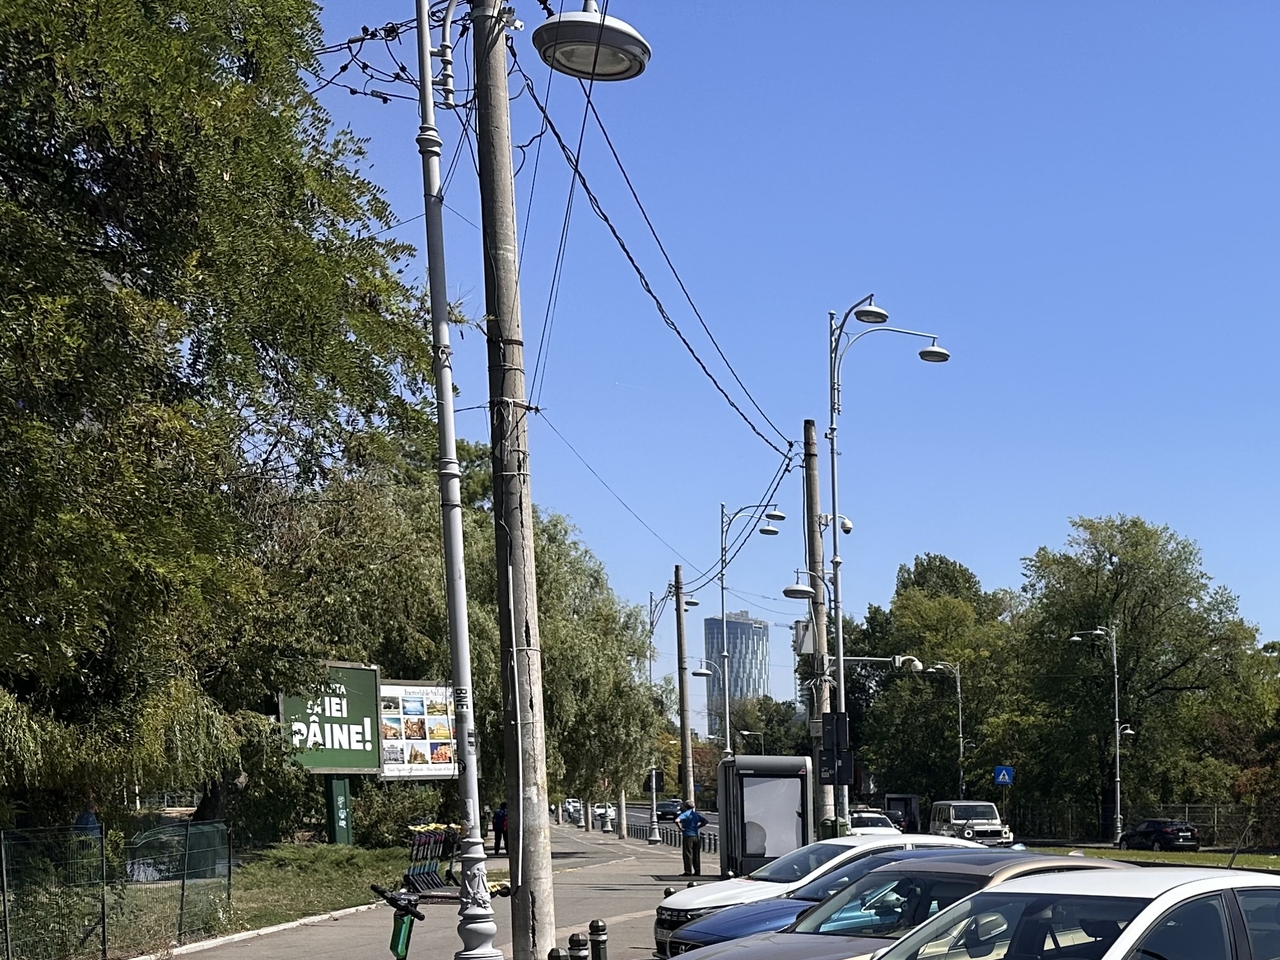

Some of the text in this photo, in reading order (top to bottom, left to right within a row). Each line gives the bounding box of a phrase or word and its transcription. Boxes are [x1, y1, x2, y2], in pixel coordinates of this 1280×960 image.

[324, 696, 348, 718] IEI
[455, 688, 469, 710] BNE
[291, 714, 373, 751] PÂINE!
